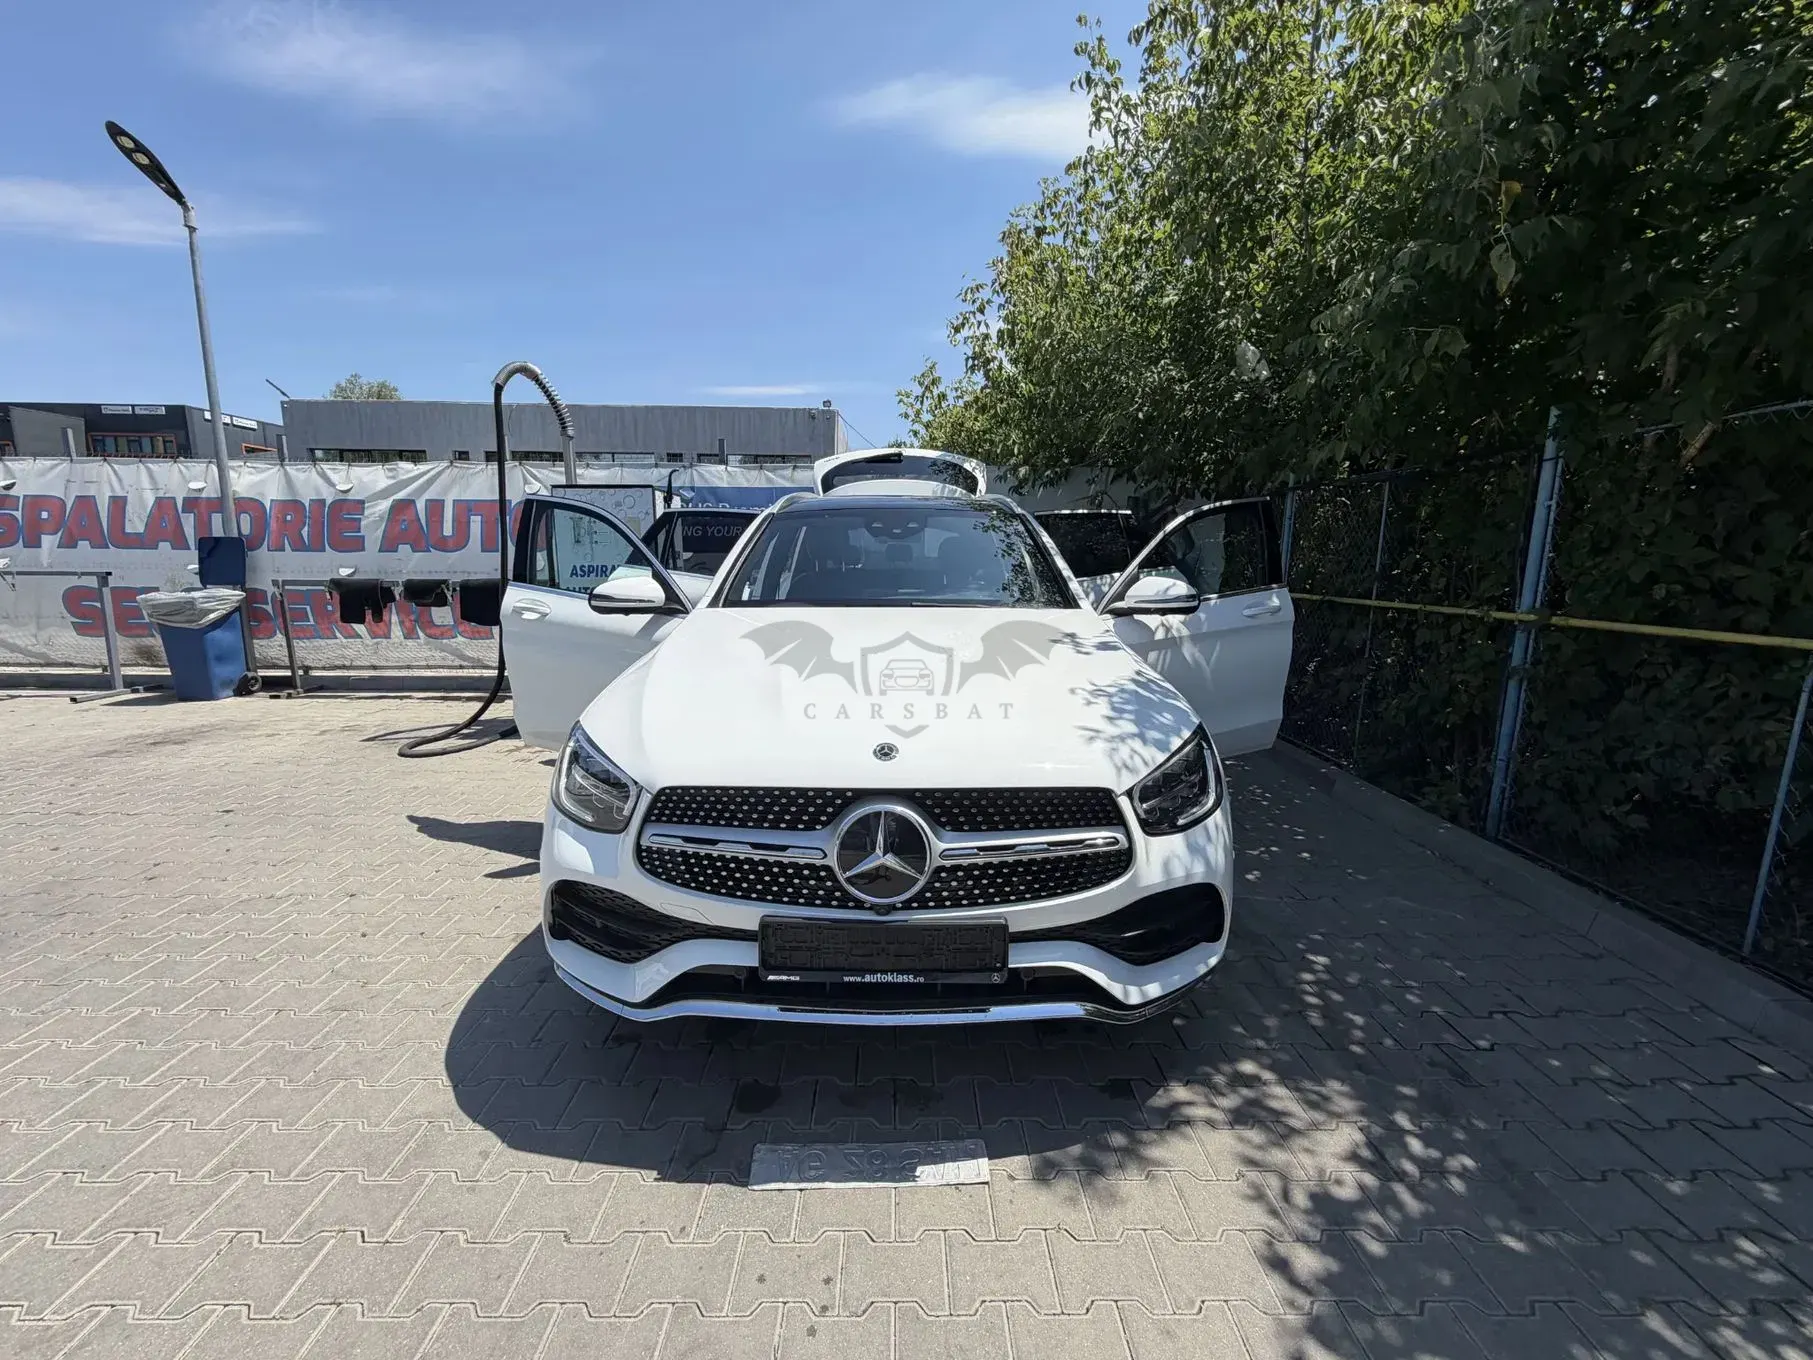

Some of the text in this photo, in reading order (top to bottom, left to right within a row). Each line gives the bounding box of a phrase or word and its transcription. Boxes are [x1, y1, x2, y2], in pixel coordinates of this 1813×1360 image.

[683, 526, 703, 537] NG
[569, 564, 622, 578] ASPIRA
[62, 585, 205, 638] SE
[843, 972, 925, 983] www.autoklass.ro
